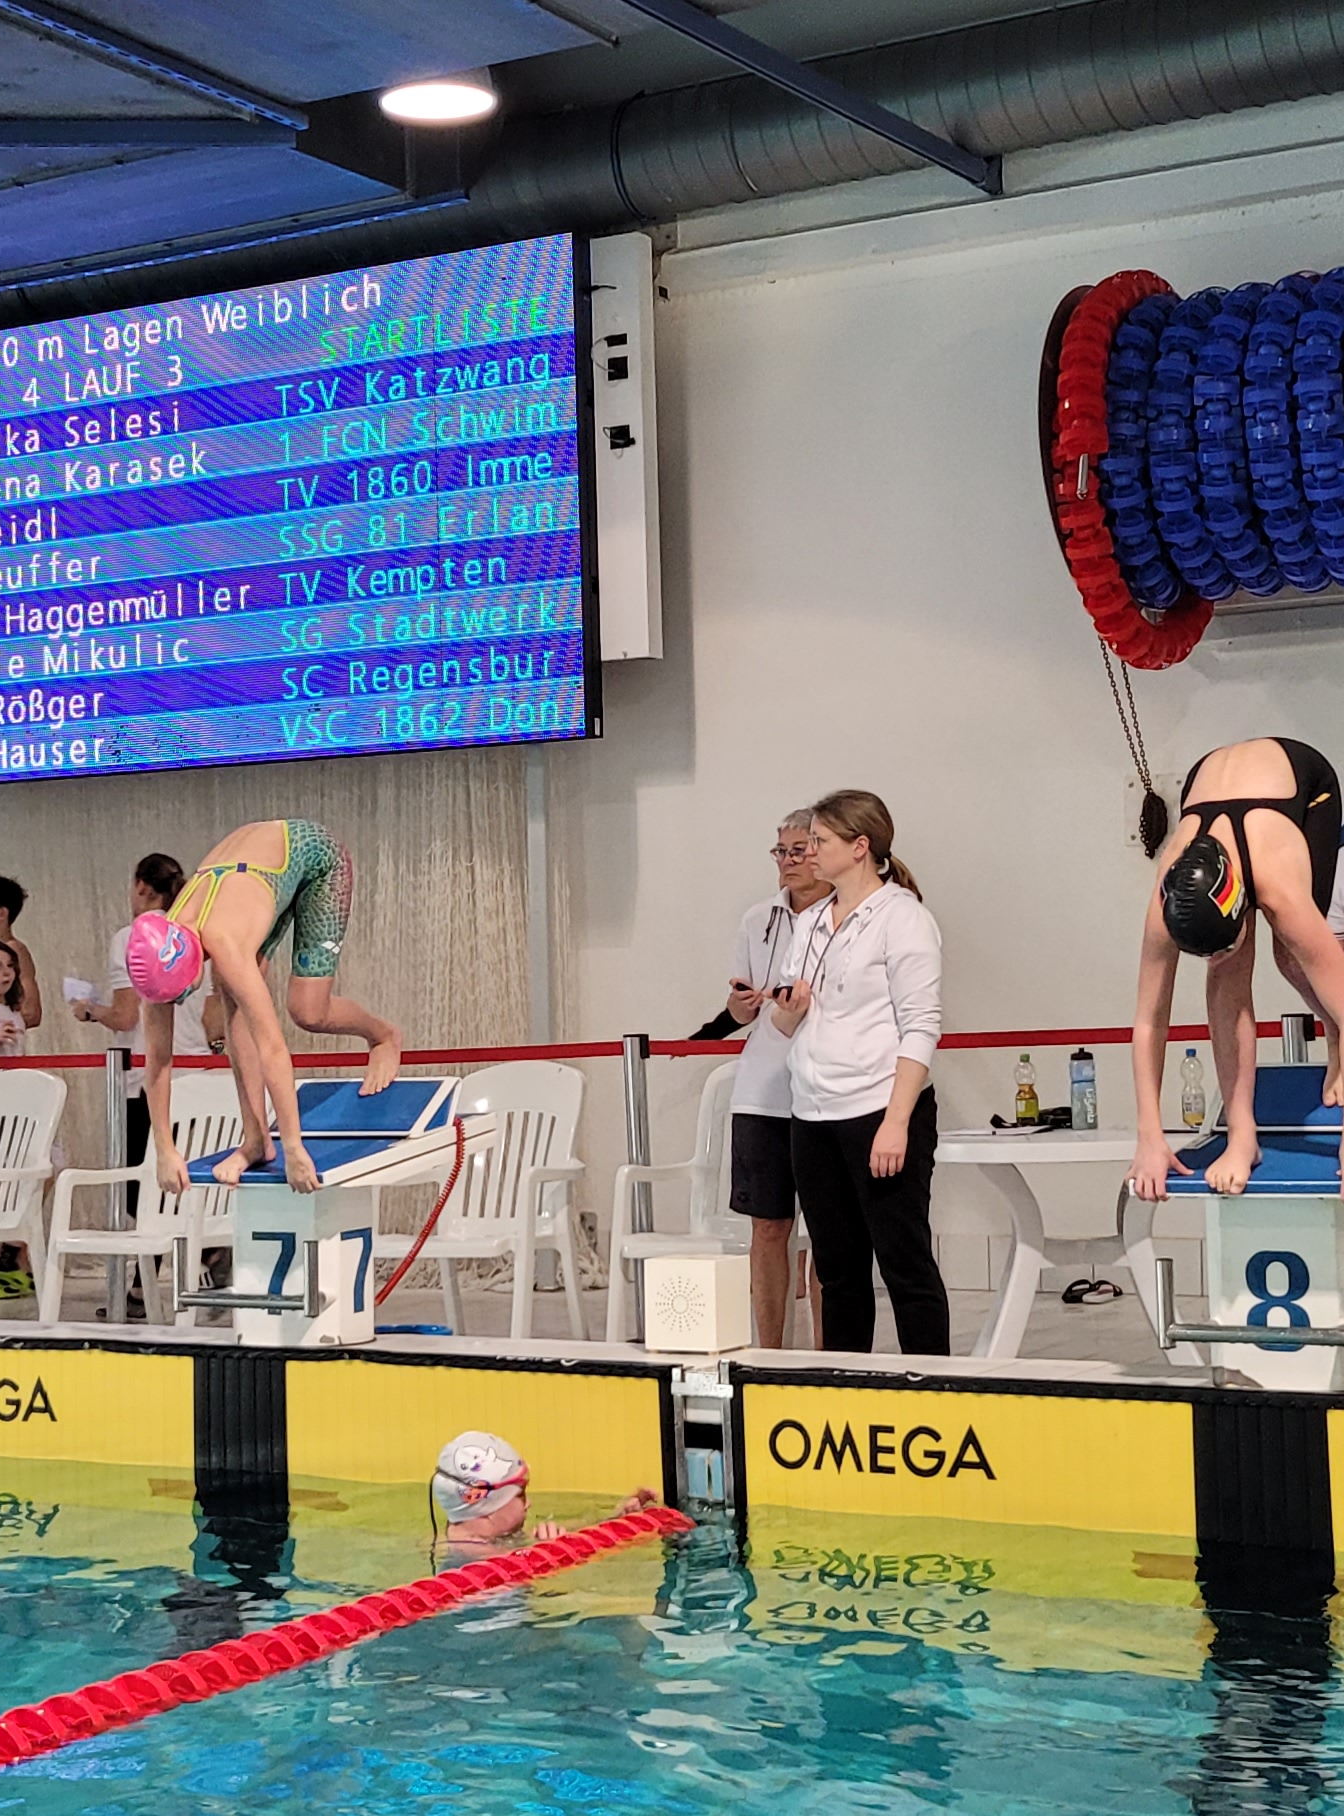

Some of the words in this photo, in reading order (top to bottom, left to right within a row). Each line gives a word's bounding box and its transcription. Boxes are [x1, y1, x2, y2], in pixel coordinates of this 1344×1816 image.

[37, 335, 64, 362] m
[84, 314, 183, 357] Lagen
[201, 273, 381, 335] Weiblich
[318, 297, 548, 363] STARTLISTE
[22, 378, 40, 408] 4
[65, 362, 141, 403] LAUF
[167, 355, 183, 388] 3
[65, 401, 180, 448] Selesi
[275, 377, 341, 417] TSV
[365, 353, 551, 405] Katzwang
[65, 441, 207, 492] Karasek
[413, 400, 557, 446] Schwim
[276, 475, 320, 511] TV
[347, 461, 432, 502] 1860
[466, 451, 552, 488] Imme
[279, 520, 344, 558] SSG
[368, 513, 406, 546] 81
[438, 497, 555, 540] Erlan
[5, 580, 251, 639] Haggenmüller
[278, 570, 321, 605] TV
[347, 556, 507, 600] Kempten
[43, 633, 189, 675] Mikulic
[280, 618, 324, 652] SG
[347, 592, 557, 646] Stadtwerk
[282, 666, 324, 701] SC
[349, 646, 556, 700] Regensbur
[279, 711, 349, 747] VSC
[375, 702, 464, 740] 1862
[490, 697, 559, 731] Don
[252, 1231, 297, 1316] 7
[340, 1226, 373, 1314] 7
[1245, 1249, 1311, 1353] 8
[767, 1418, 998, 1480] OMEGA
